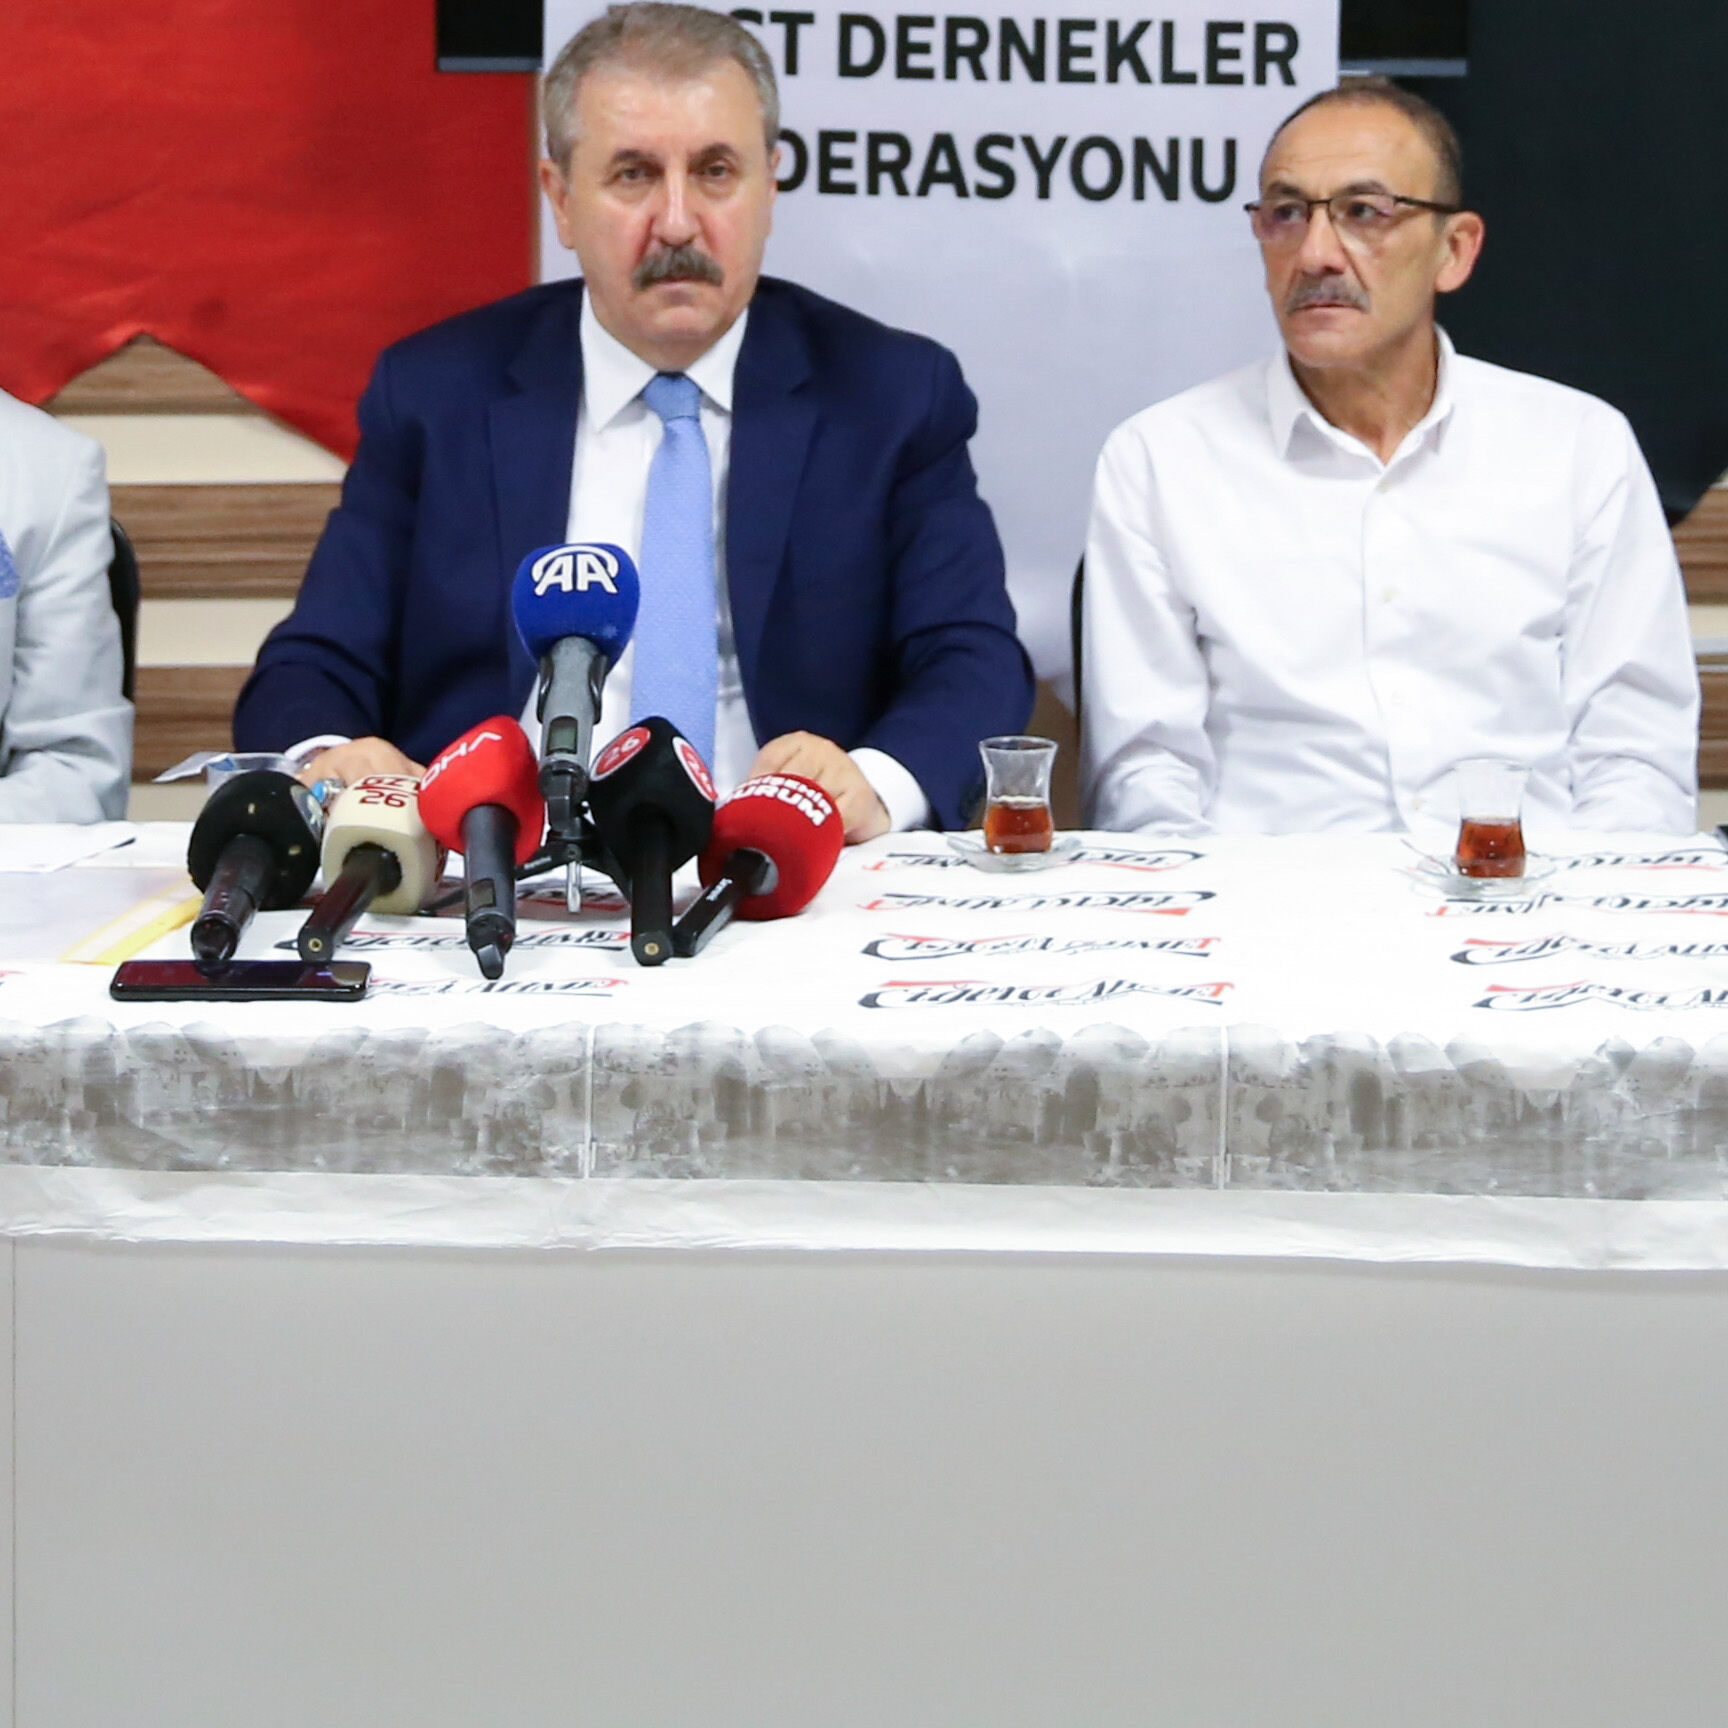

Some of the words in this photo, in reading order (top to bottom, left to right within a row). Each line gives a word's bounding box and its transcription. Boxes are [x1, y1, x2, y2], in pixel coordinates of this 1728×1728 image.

[838, 12, 1300, 87] DERNEKLER
[775, 129, 1239, 204] DERASYONU
[532, 547, 619, 597] AA
[359, 790, 409, 808] 26
